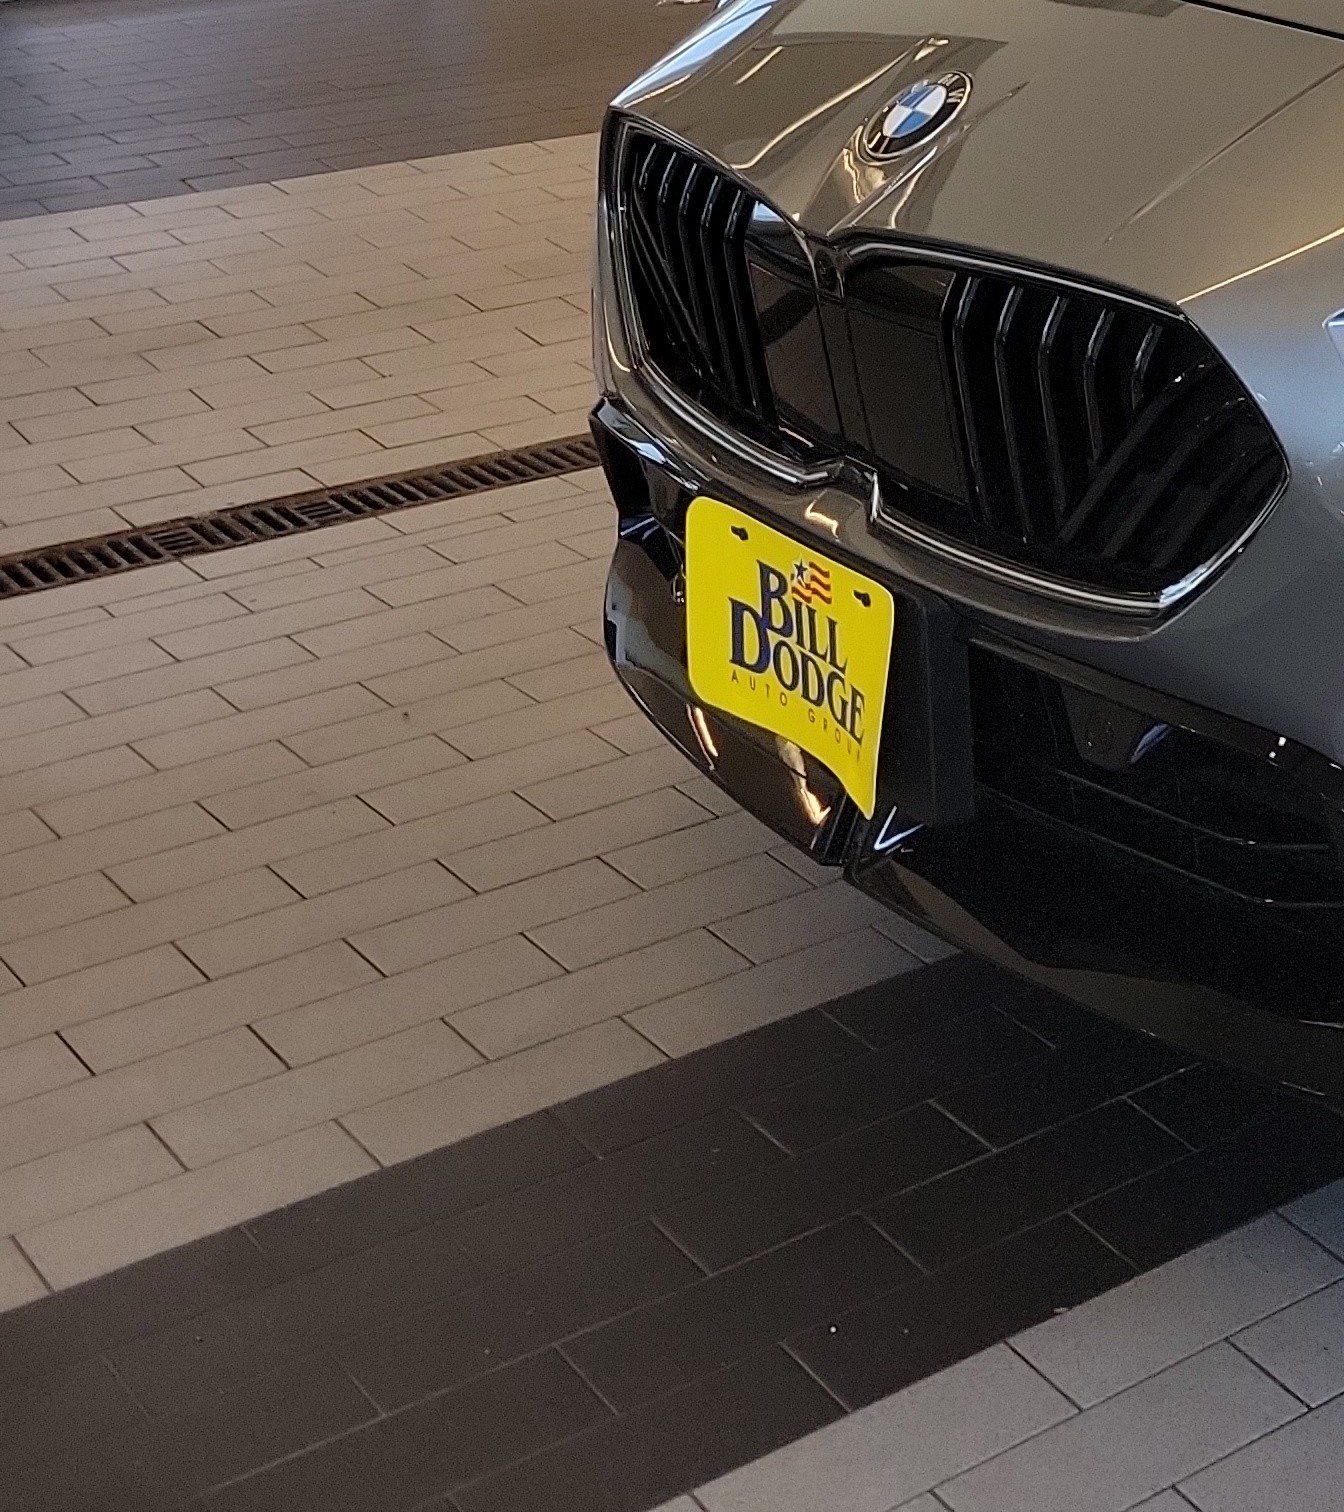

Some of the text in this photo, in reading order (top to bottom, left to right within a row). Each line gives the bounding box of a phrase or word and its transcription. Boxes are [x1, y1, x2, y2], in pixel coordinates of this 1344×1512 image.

[727, 596, 867, 746] DODGE
[756, 559, 848, 676] BILL
[730, 669, 788, 707] AUTO
